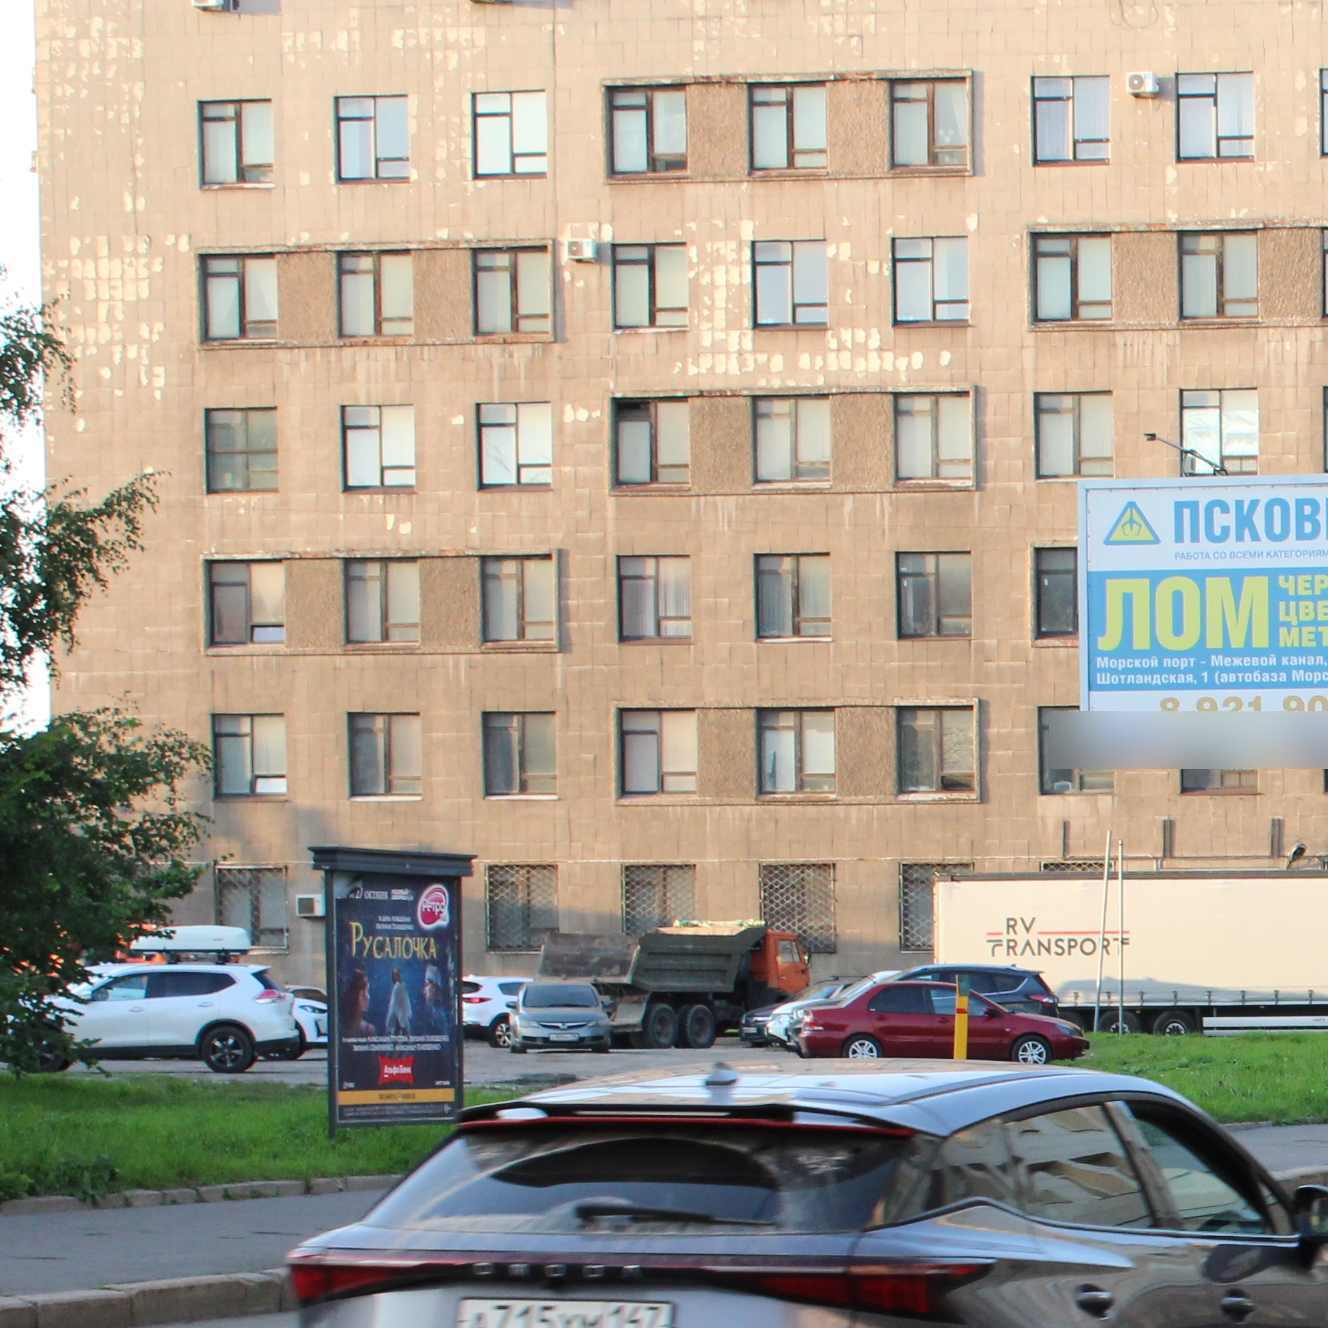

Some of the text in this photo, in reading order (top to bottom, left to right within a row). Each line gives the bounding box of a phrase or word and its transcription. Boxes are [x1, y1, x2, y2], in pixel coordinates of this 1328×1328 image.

[1174, 552, 1211, 561] РАБОТА
[1213, 551, 1227, 560] СО
[1229, 550, 1264, 560] ВСЕМИ
[1097, 576, 1270, 651] ЛОМ
[1096, 655, 1158, 671] Морской
[1163, 658, 1195, 671] порт
[1211, 654, 1277, 667] Межевой
[1202, 672, 1208, 683] 1
[1006, 917, 1036, 935] RV
[986, 938, 1130, 957] TRANSPORT
